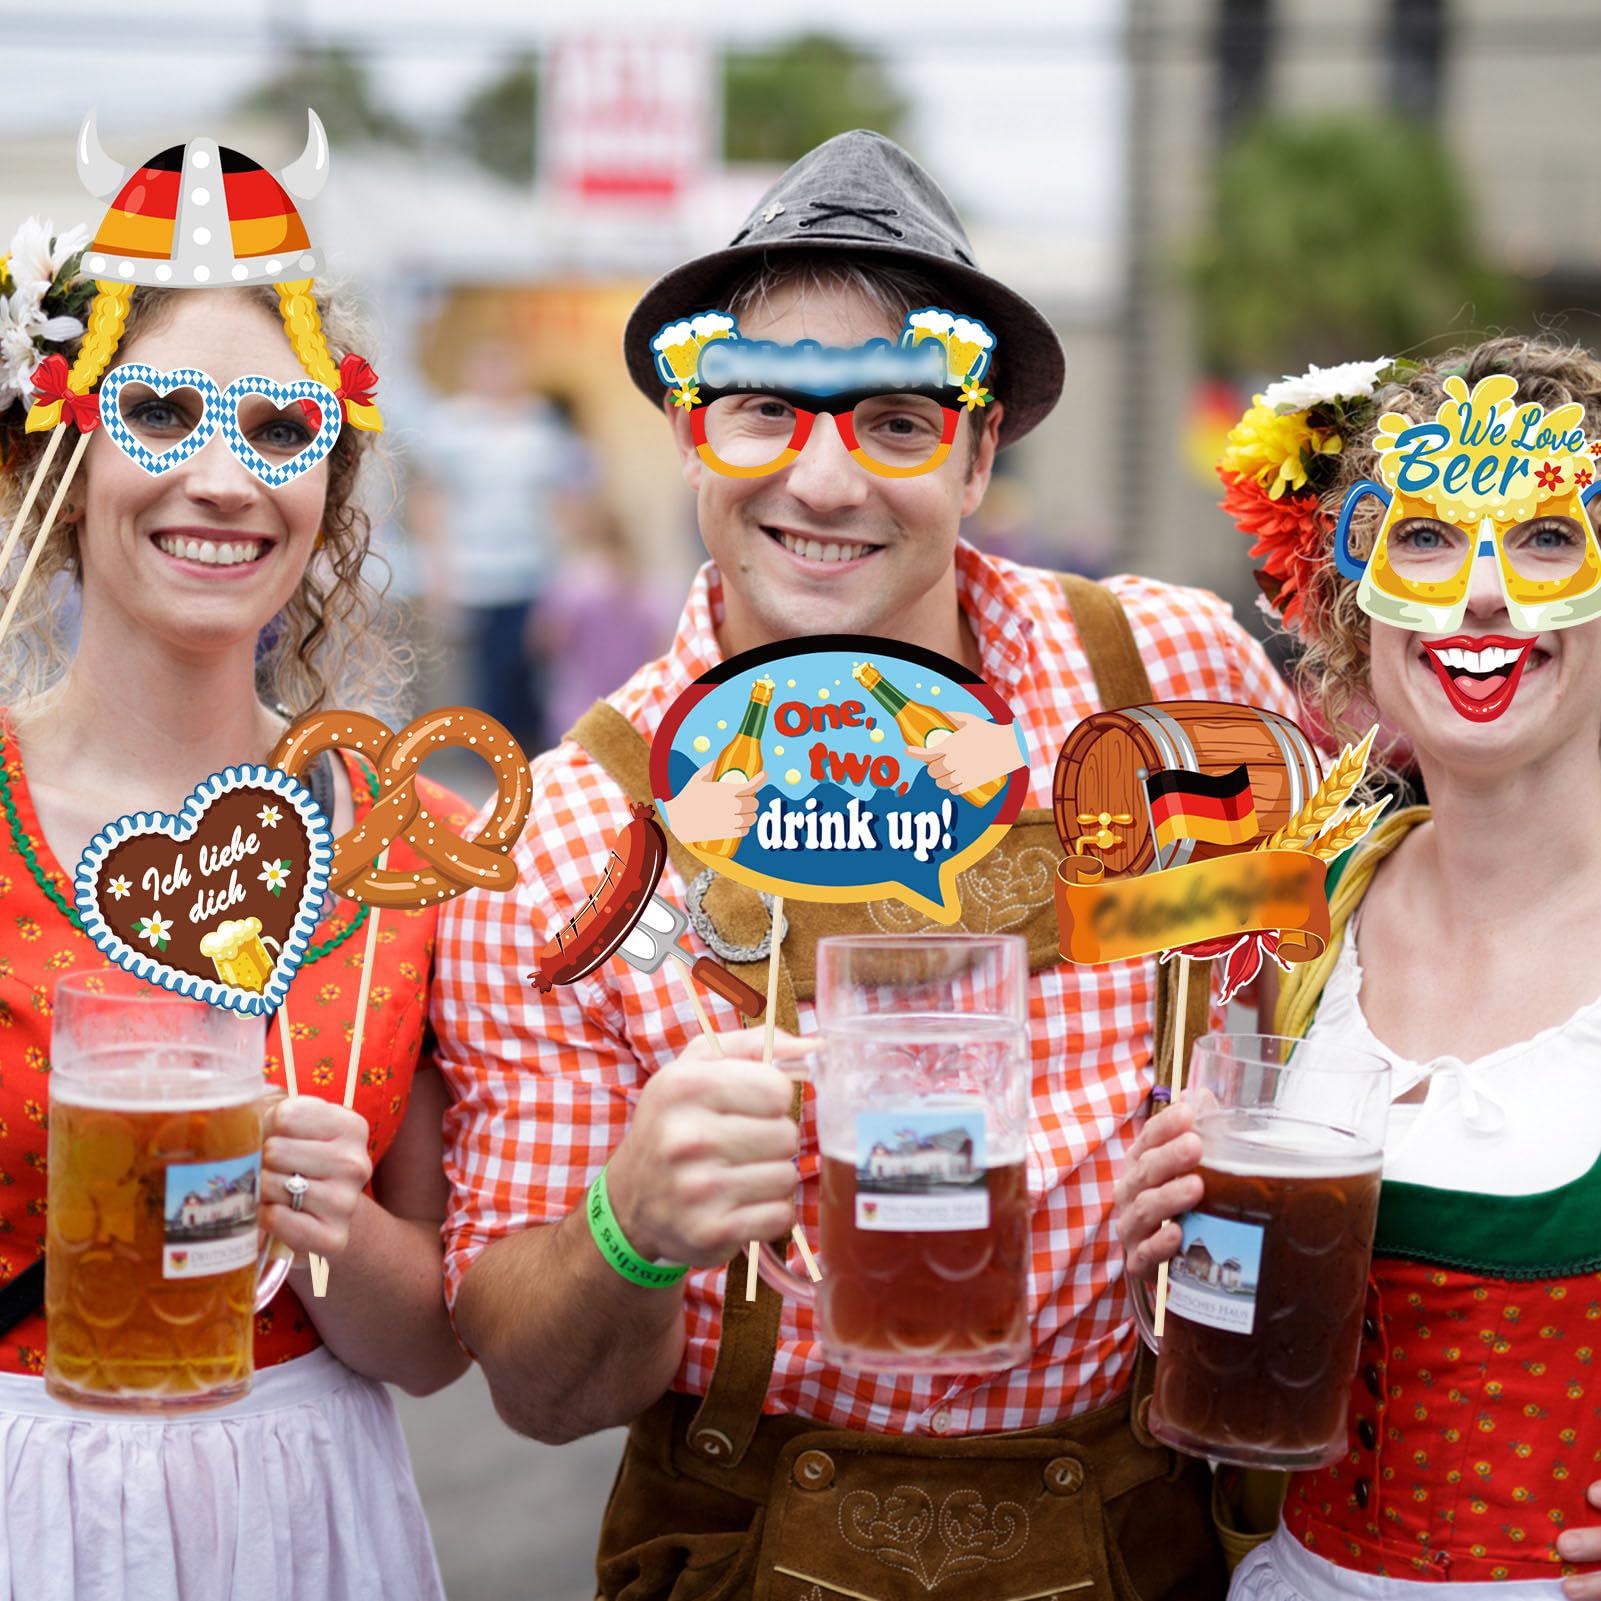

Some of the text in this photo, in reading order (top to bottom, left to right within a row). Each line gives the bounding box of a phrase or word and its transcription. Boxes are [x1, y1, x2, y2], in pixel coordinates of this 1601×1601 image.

[1457, 401, 1586, 453] We Love
[1394, 423, 1531, 497] Beer
[773, 699, 877, 738] One,
[808, 741, 910, 797] two,
[756, 797, 957, 863] drink up!
[141, 824, 261, 902] Ich liebe
[188, 868, 247, 924] dich
